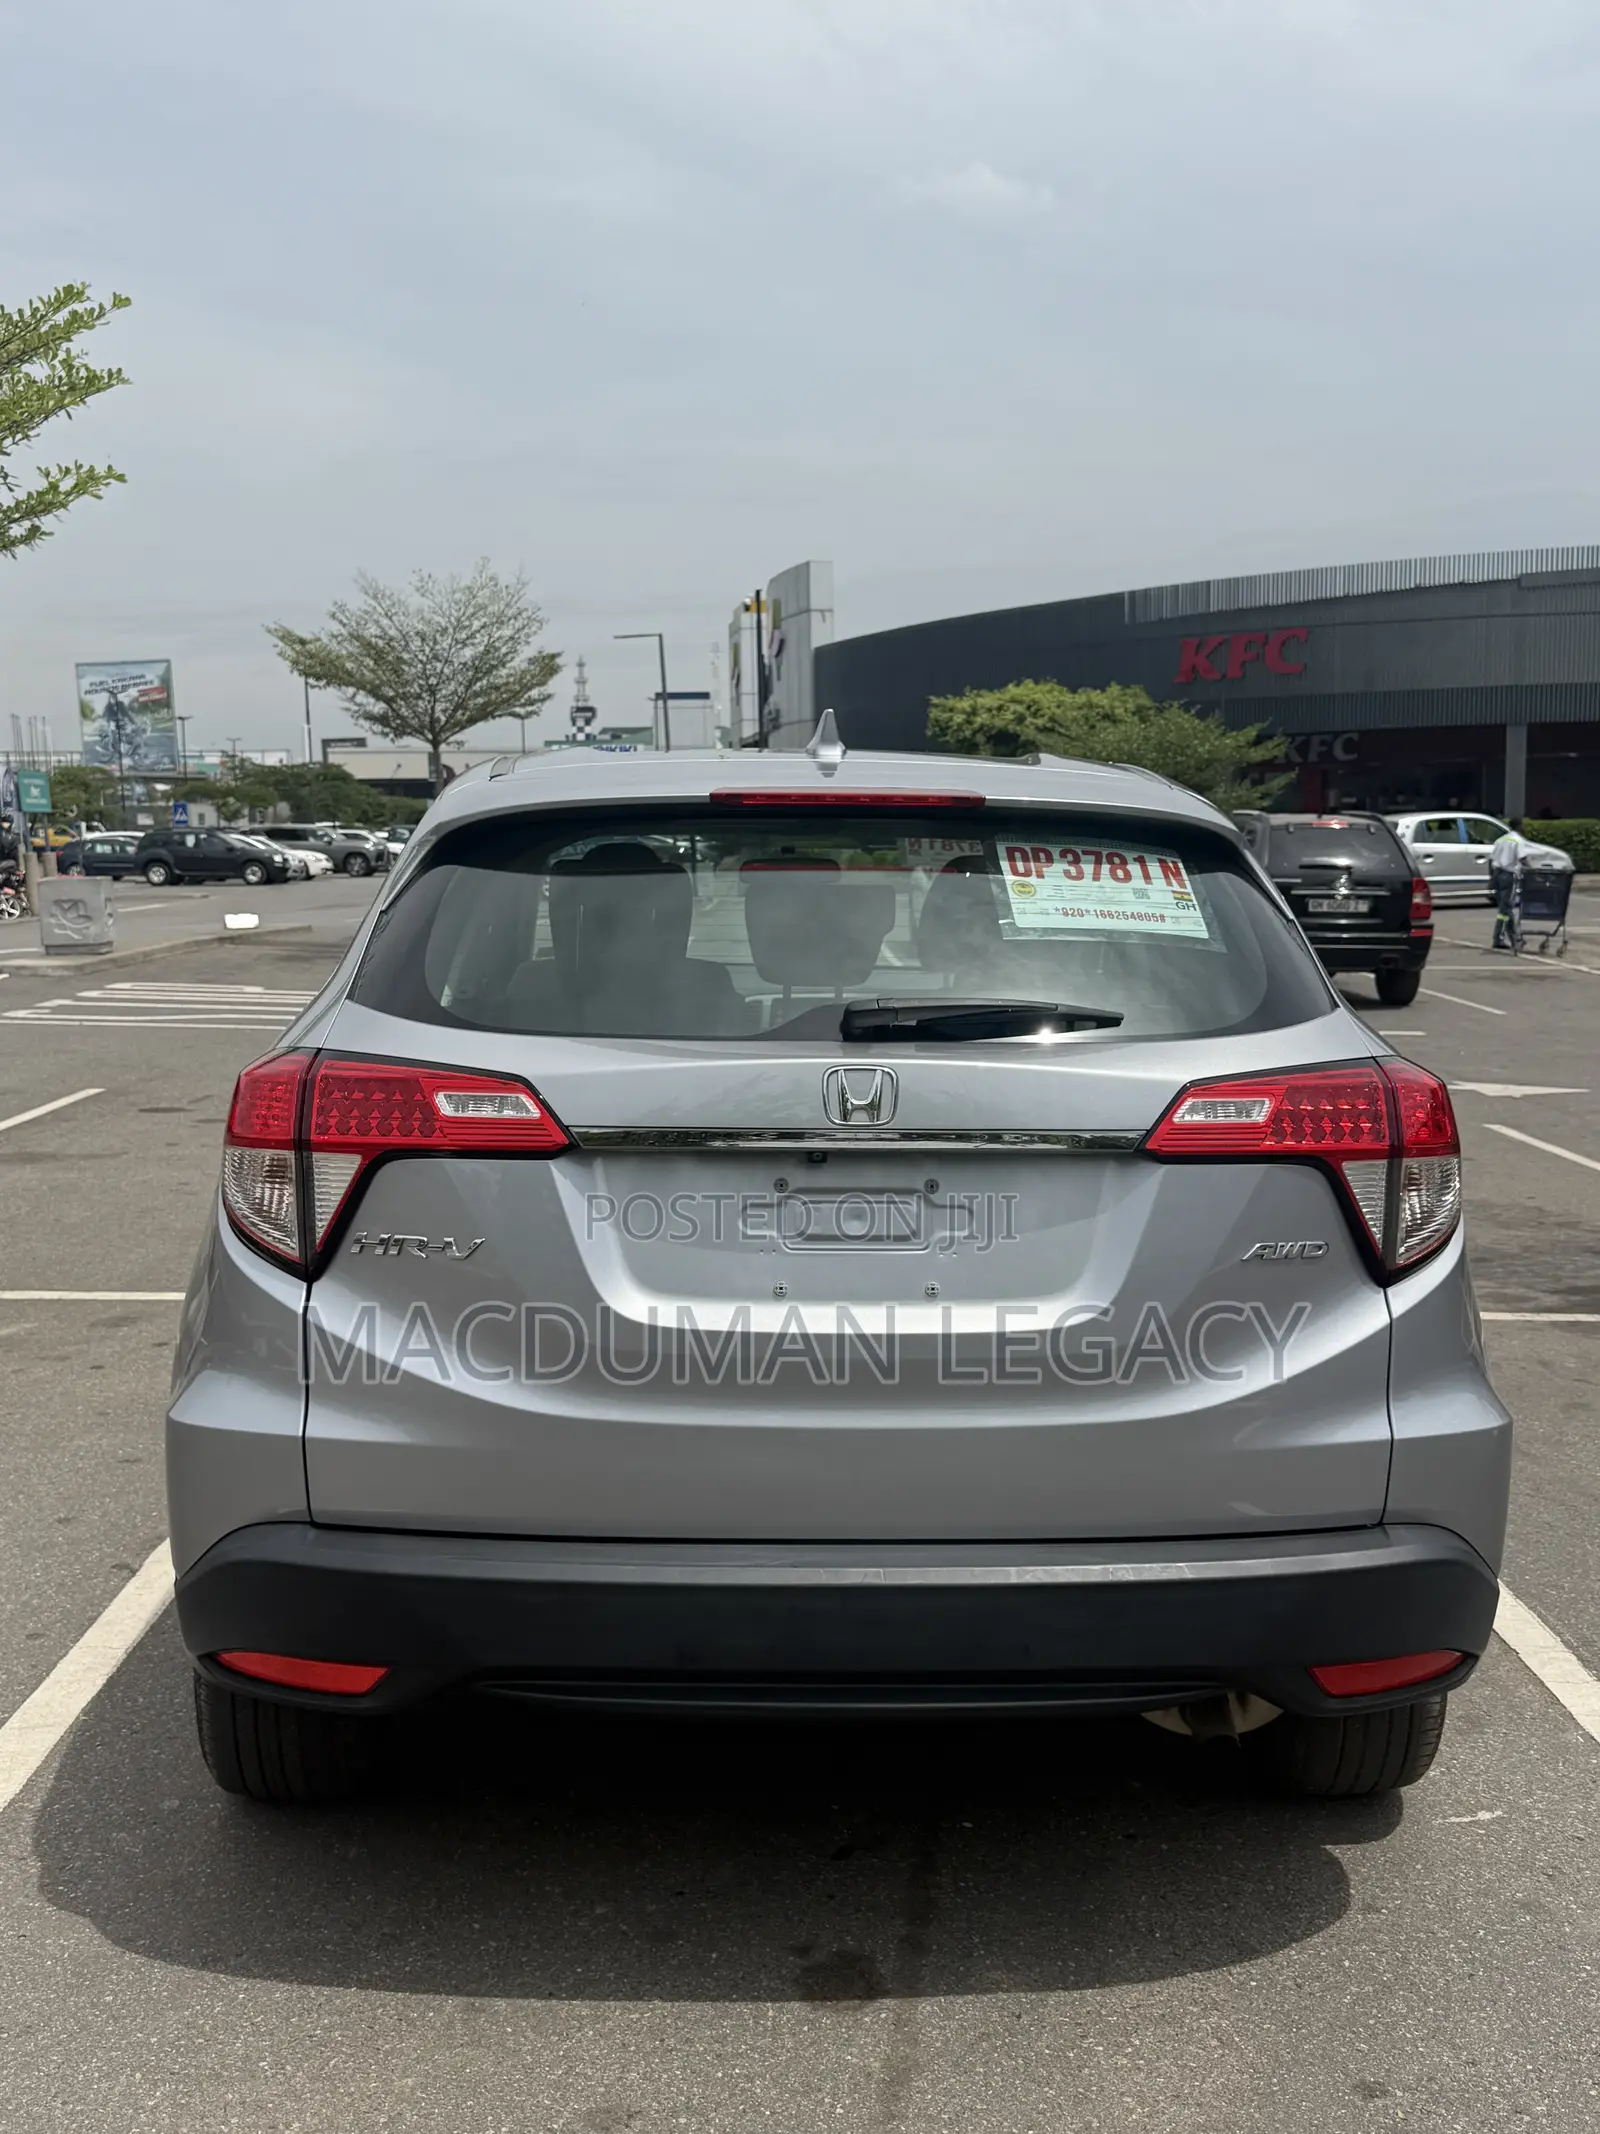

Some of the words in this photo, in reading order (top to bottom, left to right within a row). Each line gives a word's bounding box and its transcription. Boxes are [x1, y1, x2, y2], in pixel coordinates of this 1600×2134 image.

[1173, 627, 1309, 684] KFC
[1275, 733, 1360, 764] KFC
[1005, 846, 1054, 880] DP
[1058, 848, 1154, 886] 3781
[1156, 858, 1188, 890] N
[1175, 901, 1198, 912] GH
[350, 1231, 486, 1260] HR-V
[1241, 1240, 1330, 1261] AWD
